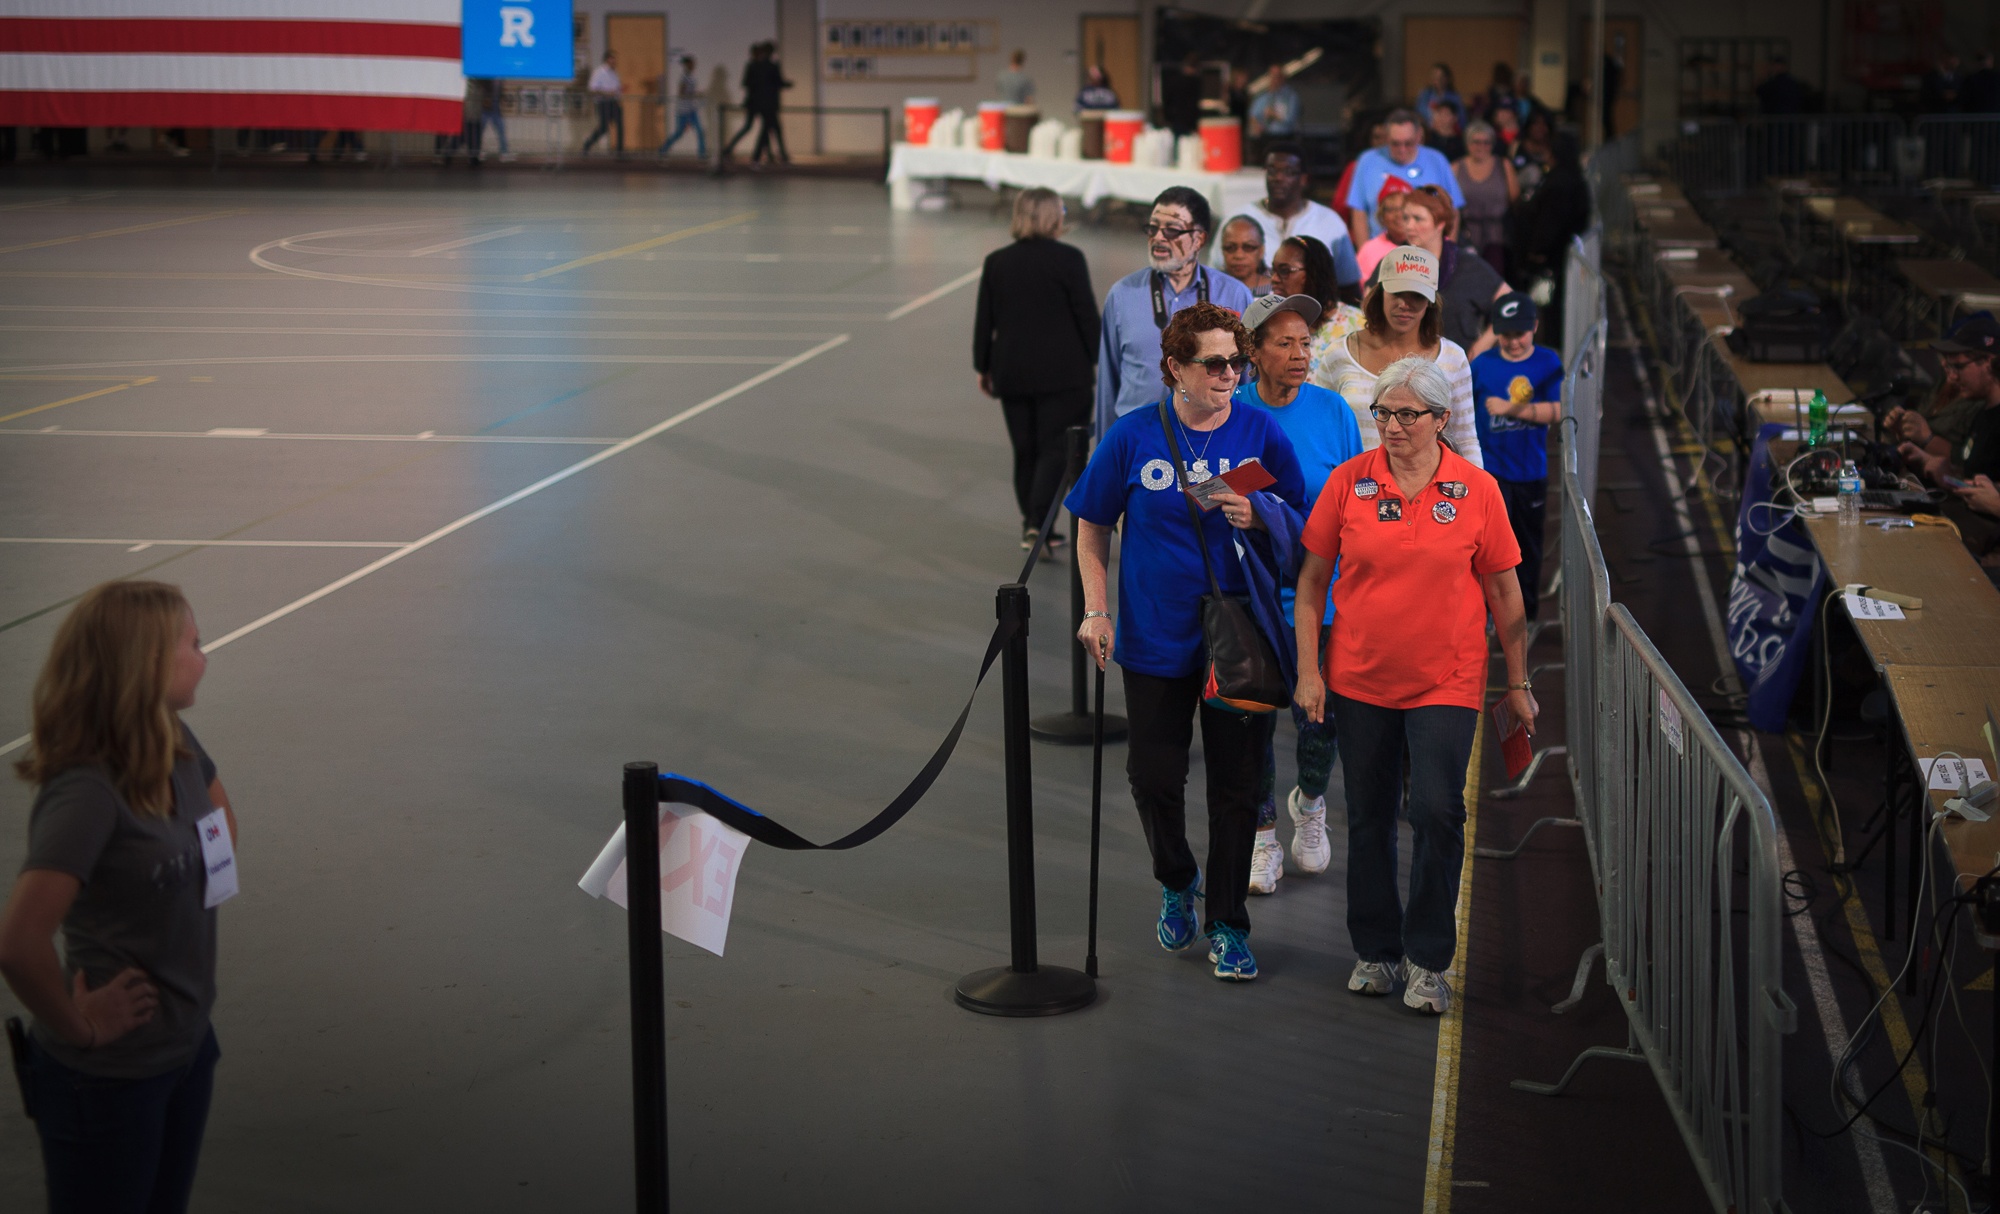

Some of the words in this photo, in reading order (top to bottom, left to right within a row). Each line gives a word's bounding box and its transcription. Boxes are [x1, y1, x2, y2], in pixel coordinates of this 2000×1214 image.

[1403, 254, 1427, 263] NASTY
[1396, 261, 1430, 275] Woman
[1153, 290, 1162, 313] Canon
